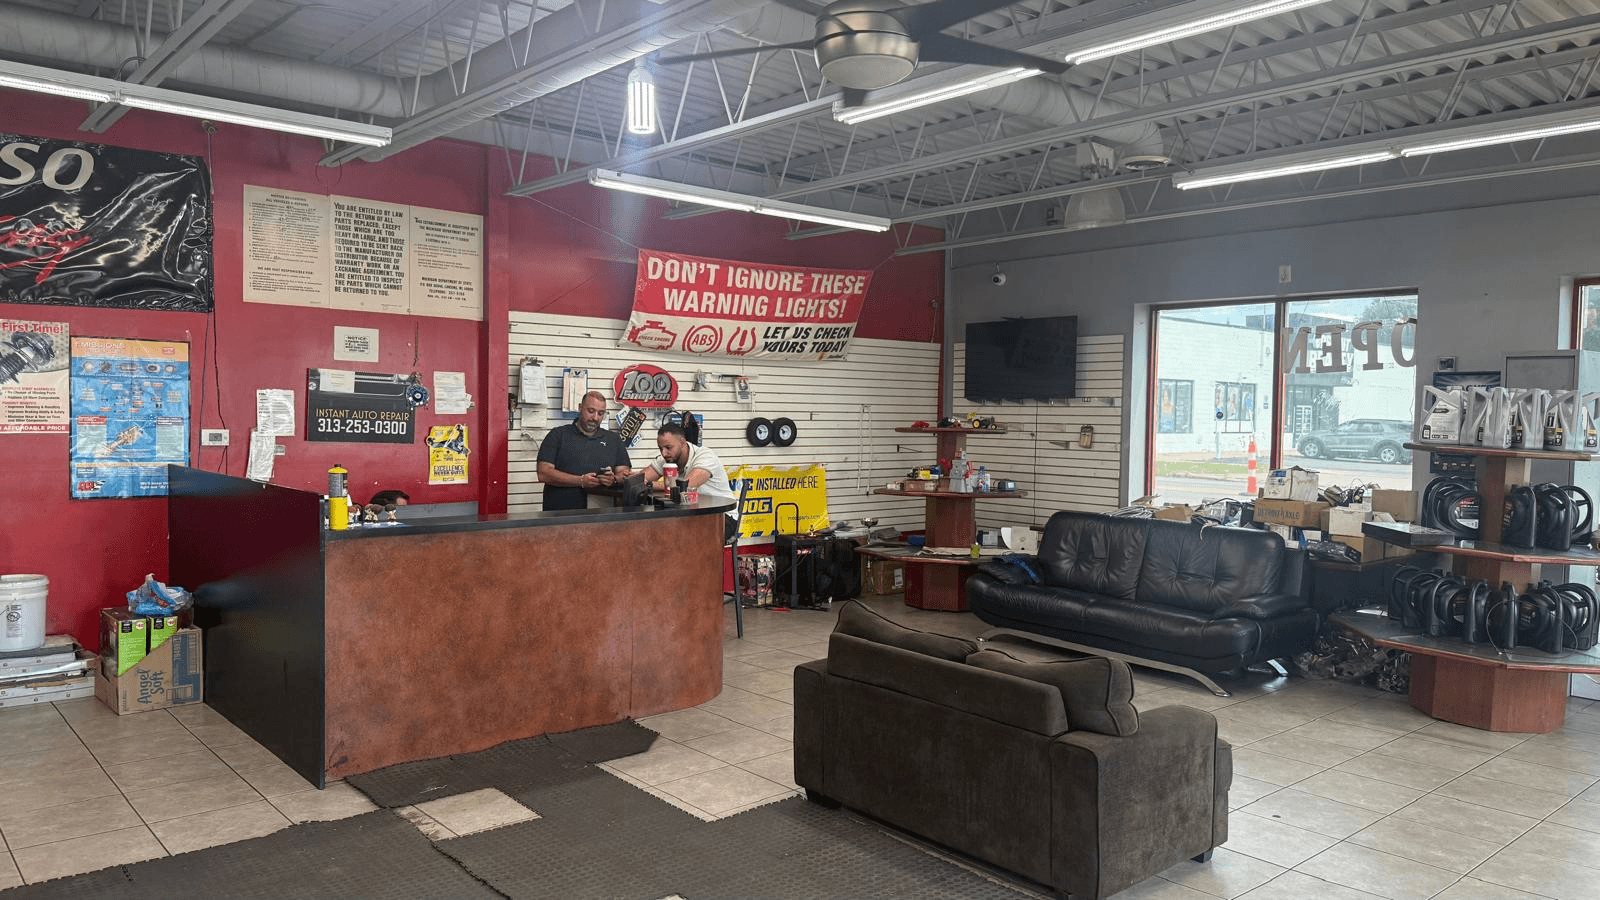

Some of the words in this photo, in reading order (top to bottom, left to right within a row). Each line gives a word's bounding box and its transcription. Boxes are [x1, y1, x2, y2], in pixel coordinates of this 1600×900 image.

[334, 201, 345, 210] YOU
[359, 207, 382, 215] ENTITLED
[354, 219, 380, 228] REPLACED,
[335, 238, 359, 246] REQUIRED
[355, 247, 394, 256] MANUFACTURER
[335, 259, 364, 267] WARRANTY
[647, 257, 719, 285] DON'T
[727, 266, 804, 292] IGNORE
[811, 272, 866, 295] THESE
[663, 287, 769, 317] WARNING
[774, 297, 847, 319] LIGHTS!
[2, 322, 29, 332] First
[32, 324, 63, 334] Time!
[763, 326, 790, 339] LET
[792, 327, 810, 339] US
[813, 327, 852, 339] CHECK
[692, 333, 714, 346] ABS
[763, 341, 806, 353] YOURS
[810, 341, 847, 352] TODAY
[619, 370, 672, 399] 100
[316, 408, 349, 418] INSTANT
[352, 410, 377, 419] AUTO
[380, 411, 410, 421] REPAIR
[318, 418, 407, 434] 313-253-0300
[756, 477, 796, 490] INSTALLED
[798, 476, 818, 489] HERE
[1284, 511, 1300, 520] AXLE
[136, 666, 152, 704] Angel
[150, 670, 166, 695] Soft
